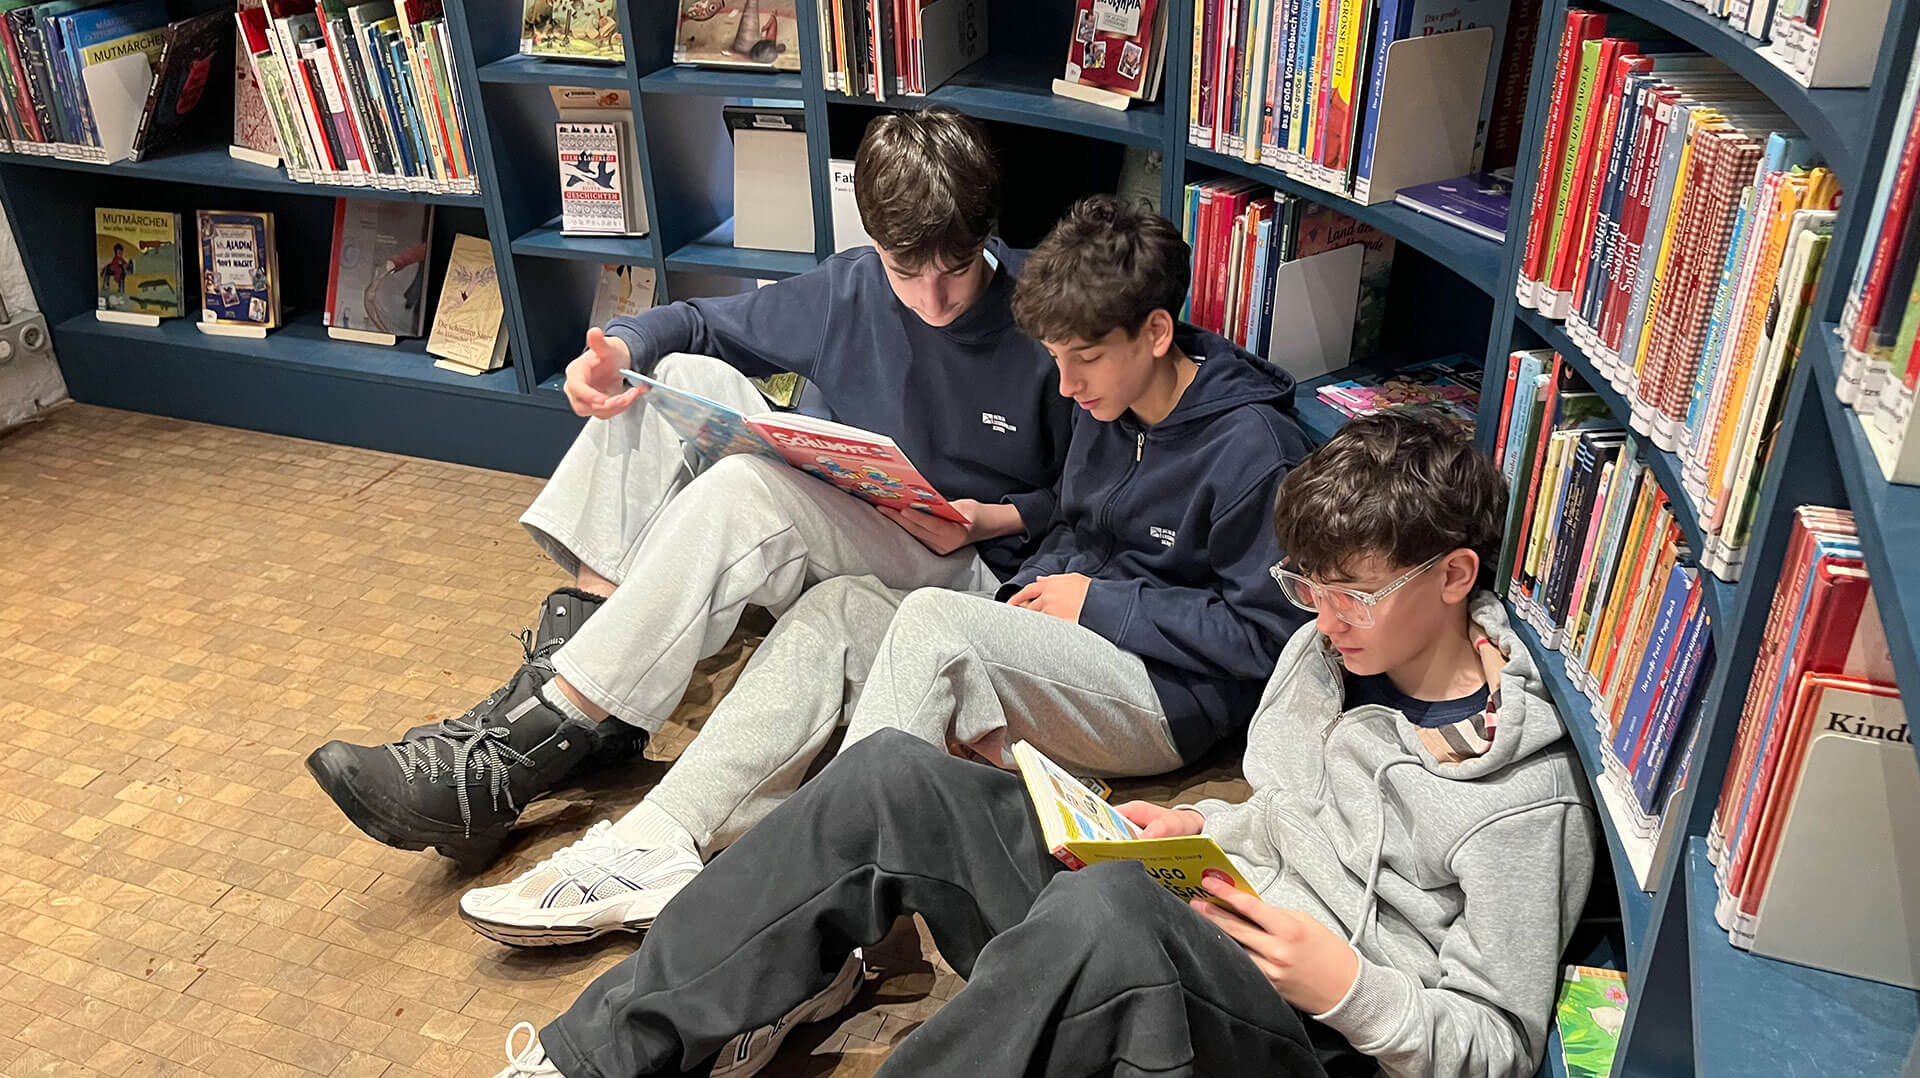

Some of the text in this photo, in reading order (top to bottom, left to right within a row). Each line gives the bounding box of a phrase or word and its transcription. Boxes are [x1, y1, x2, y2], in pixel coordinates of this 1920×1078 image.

[94, 33, 167, 62] MUTMÄRCHEN
[1285, 16, 1299, 79] Vorlesebuch
[1296, 55, 1304, 75] Buch
[1335, 46, 1344, 77] BUCH
[1283, 81, 1293, 113] große
[1294, 77, 1302, 102] große
[1281, 113, 1290, 130] Das
[1292, 103, 1300, 119] Das
[1540, 140, 1554, 190] Geschichten
[1556, 81, 1564, 105] Maus
[103, 213, 168, 228] MUTMÄRCHEN
[226, 239, 252, 251] ALADIN
[1619, 242, 1641, 294] Snöfrid
[1147, 867, 1186, 880] UGO
